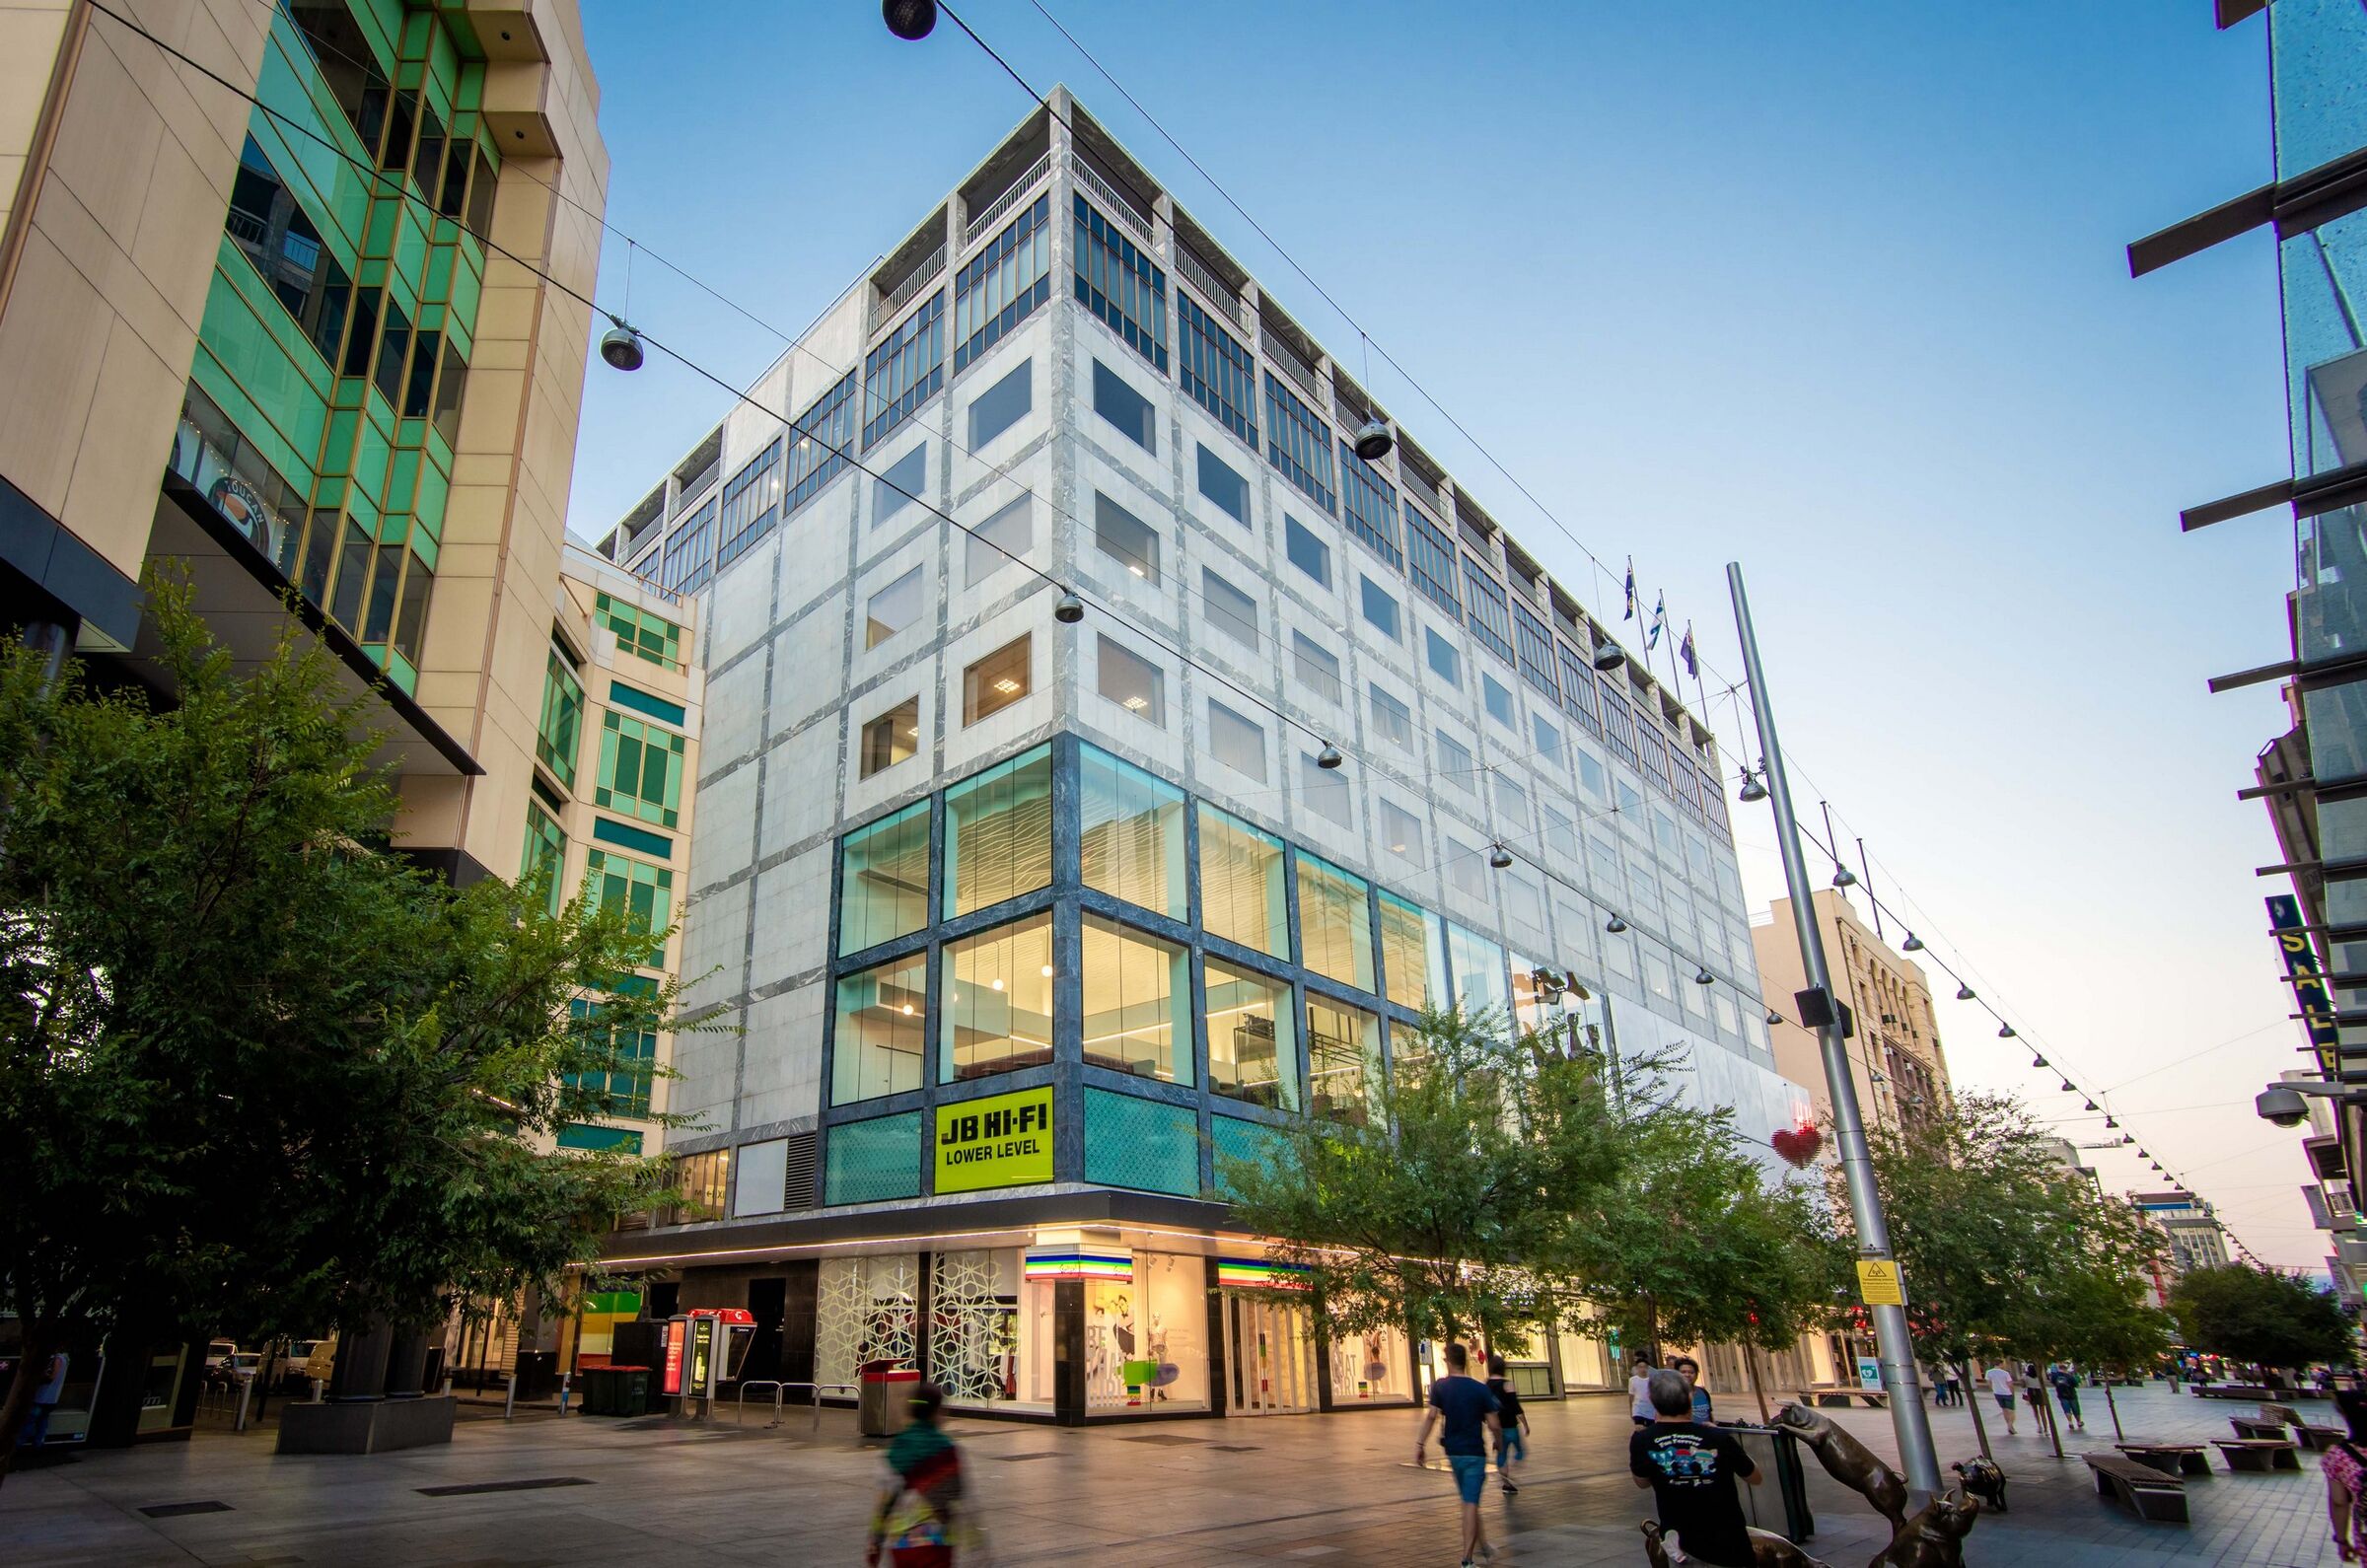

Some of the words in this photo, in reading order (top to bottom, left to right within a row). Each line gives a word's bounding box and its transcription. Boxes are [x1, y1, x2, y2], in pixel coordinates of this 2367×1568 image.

[941, 1115, 978, 1145] JB
[947, 1146, 992, 1166] LOWER
[997, 1139, 1040, 1158] LEVEL
